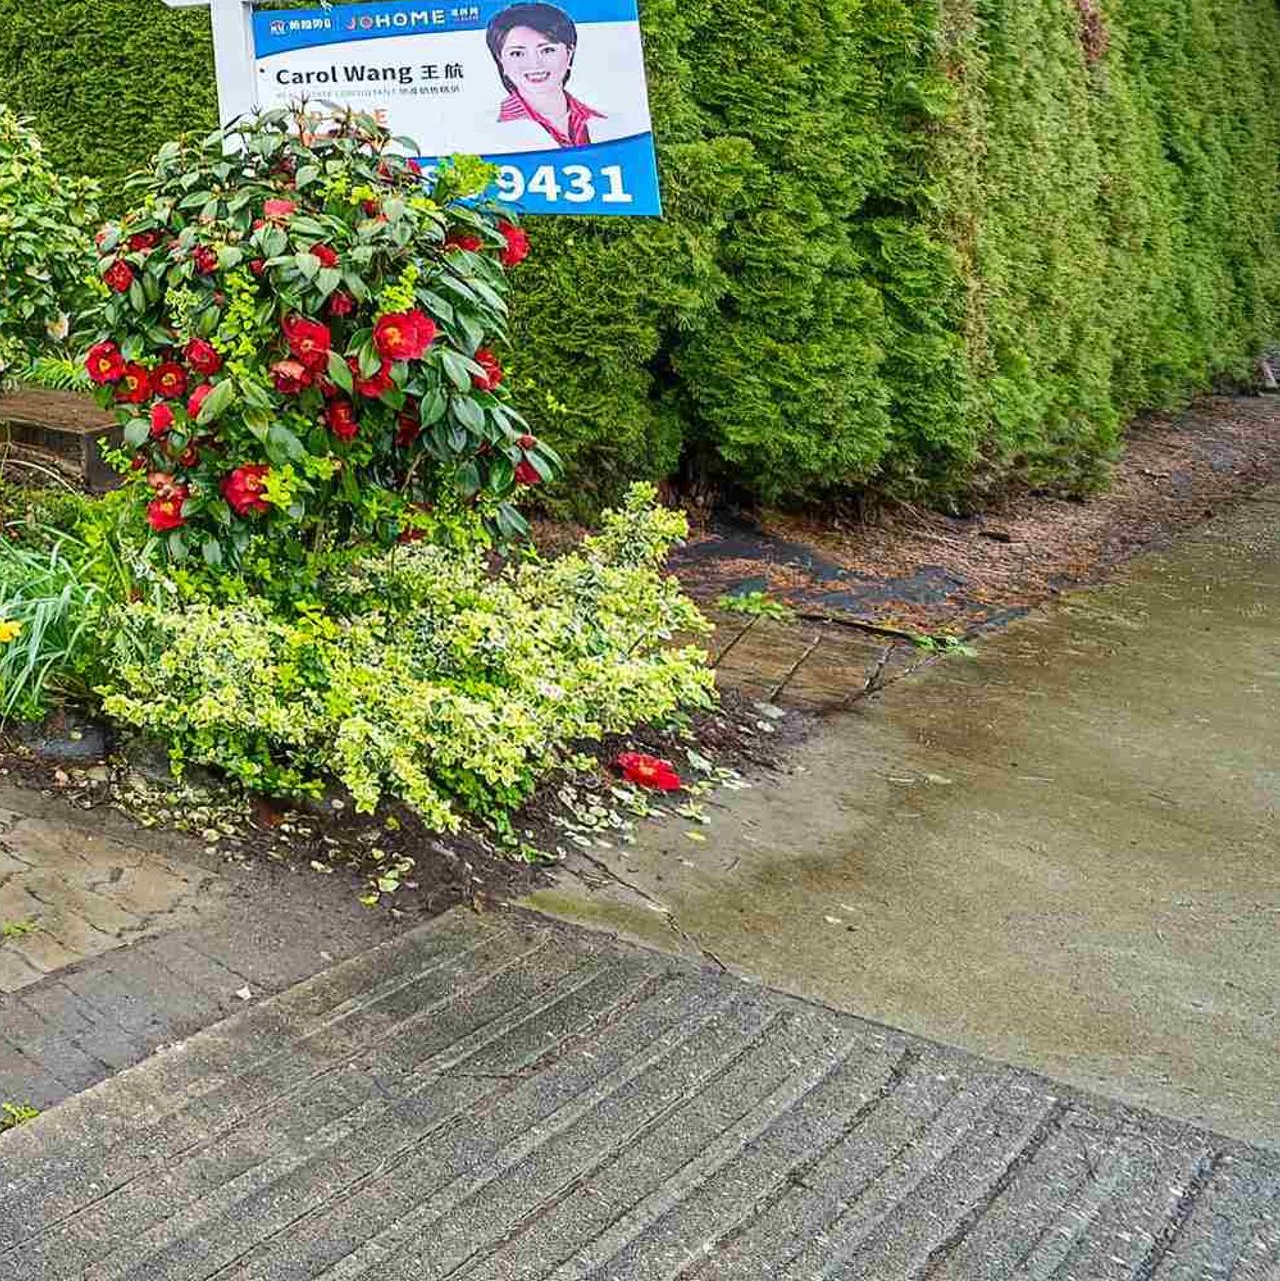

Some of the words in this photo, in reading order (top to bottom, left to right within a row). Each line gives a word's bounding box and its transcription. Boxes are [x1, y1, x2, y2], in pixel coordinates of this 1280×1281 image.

[346, 9, 445, 30] JOHOME
[276, 65, 338, 85] Carol
[343, 65, 414, 85] Wang
